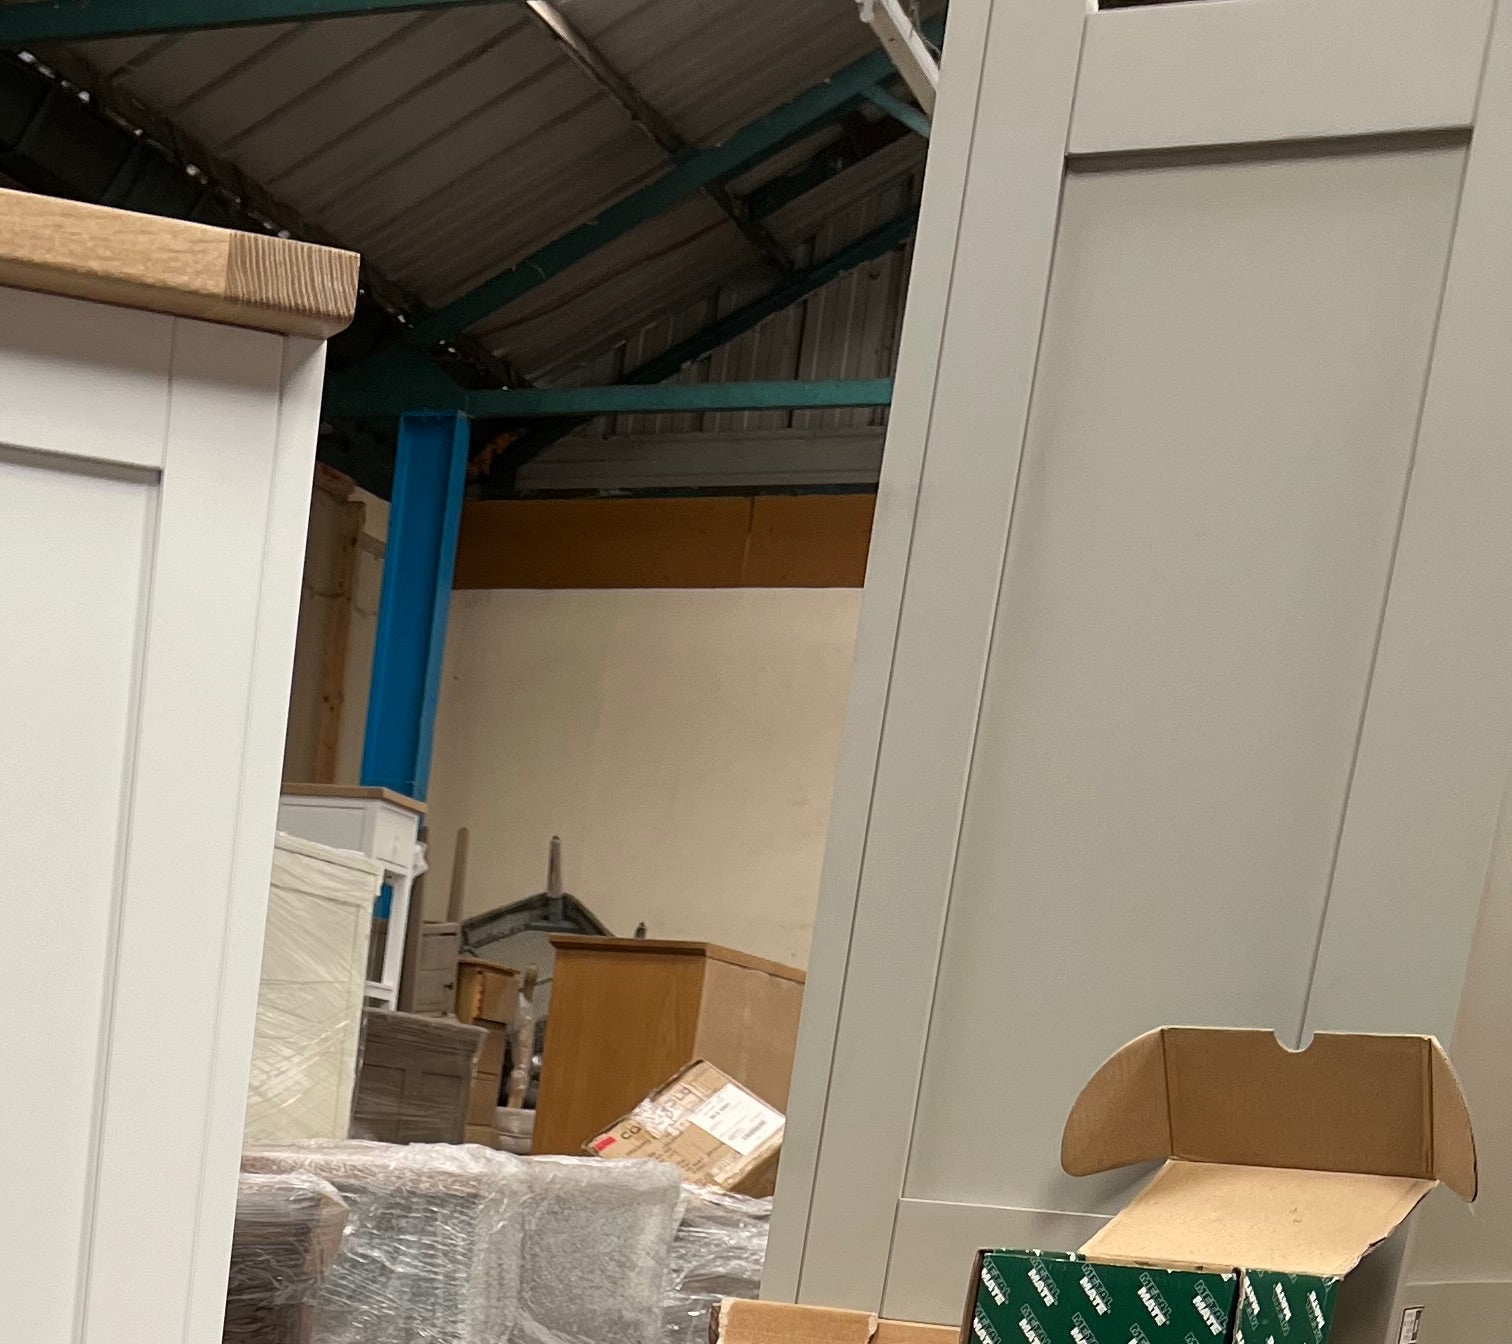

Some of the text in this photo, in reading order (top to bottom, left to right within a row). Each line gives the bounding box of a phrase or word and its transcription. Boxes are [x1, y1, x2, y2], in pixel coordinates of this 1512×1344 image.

[981, 1267, 1005, 1306] MATE
[1028, 1268, 1055, 1307] MATE
[1030, 1258, 1060, 1300] METAL
[1080, 1276, 1108, 1316] MATE
[1081, 1263, 1113, 1308] METAL
[1139, 1272, 1172, 1319] METAL
[1137, 1286, 1166, 1327] MATE
[1192, 1295, 1222, 1336] MATE
[1194, 1280, 1228, 1329] METAL
